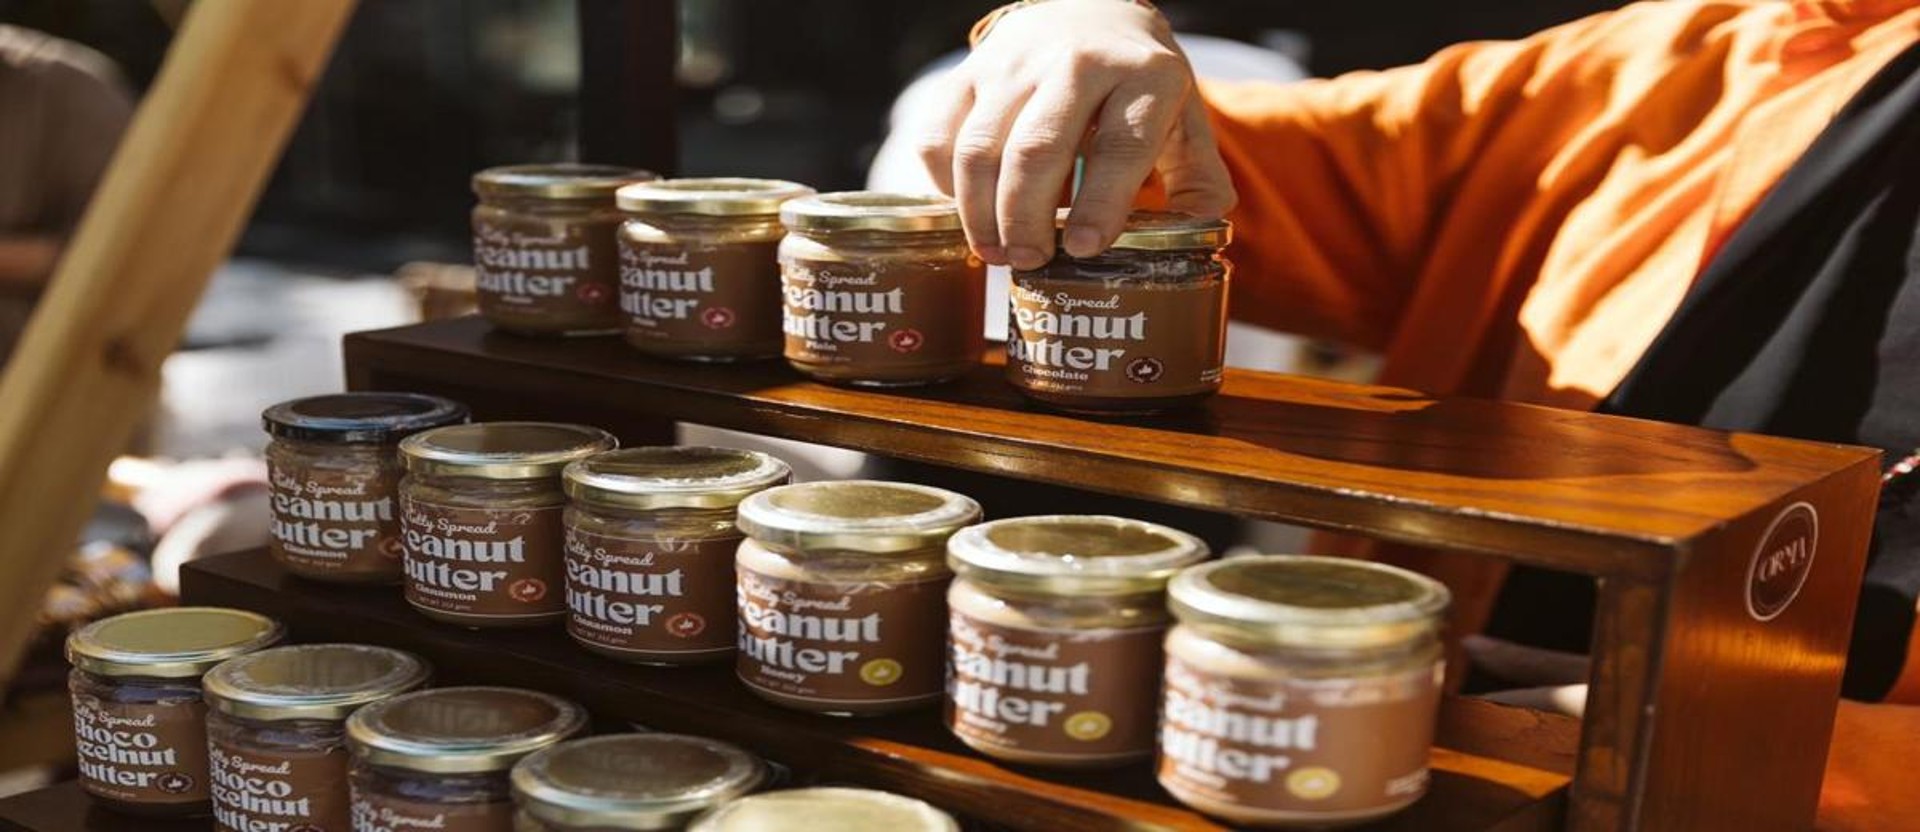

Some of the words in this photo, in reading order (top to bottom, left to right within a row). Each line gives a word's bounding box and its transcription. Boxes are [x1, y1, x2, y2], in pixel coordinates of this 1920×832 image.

[819, 270, 878, 289] Spread
[783, 281, 904, 314] eanut
[1054, 292, 1120, 312] Spread
[784, 309, 886, 342] utter
[1022, 364, 1089, 381] Chocolate
[306, 481, 367, 498] Spread
[271, 490, 393, 521] eanut
[437, 517, 498, 536] Spread
[594, 548, 654, 567] Spread
[567, 559, 685, 596] eanut
[415, 584, 476, 601] Cinnamon
[566, 588, 664, 626] utter
[98, 711, 156, 728] Spread
[77, 742, 176, 765] zelnut
[231, 756, 290, 774] Spread
[211, 784, 310, 816] zelnut
